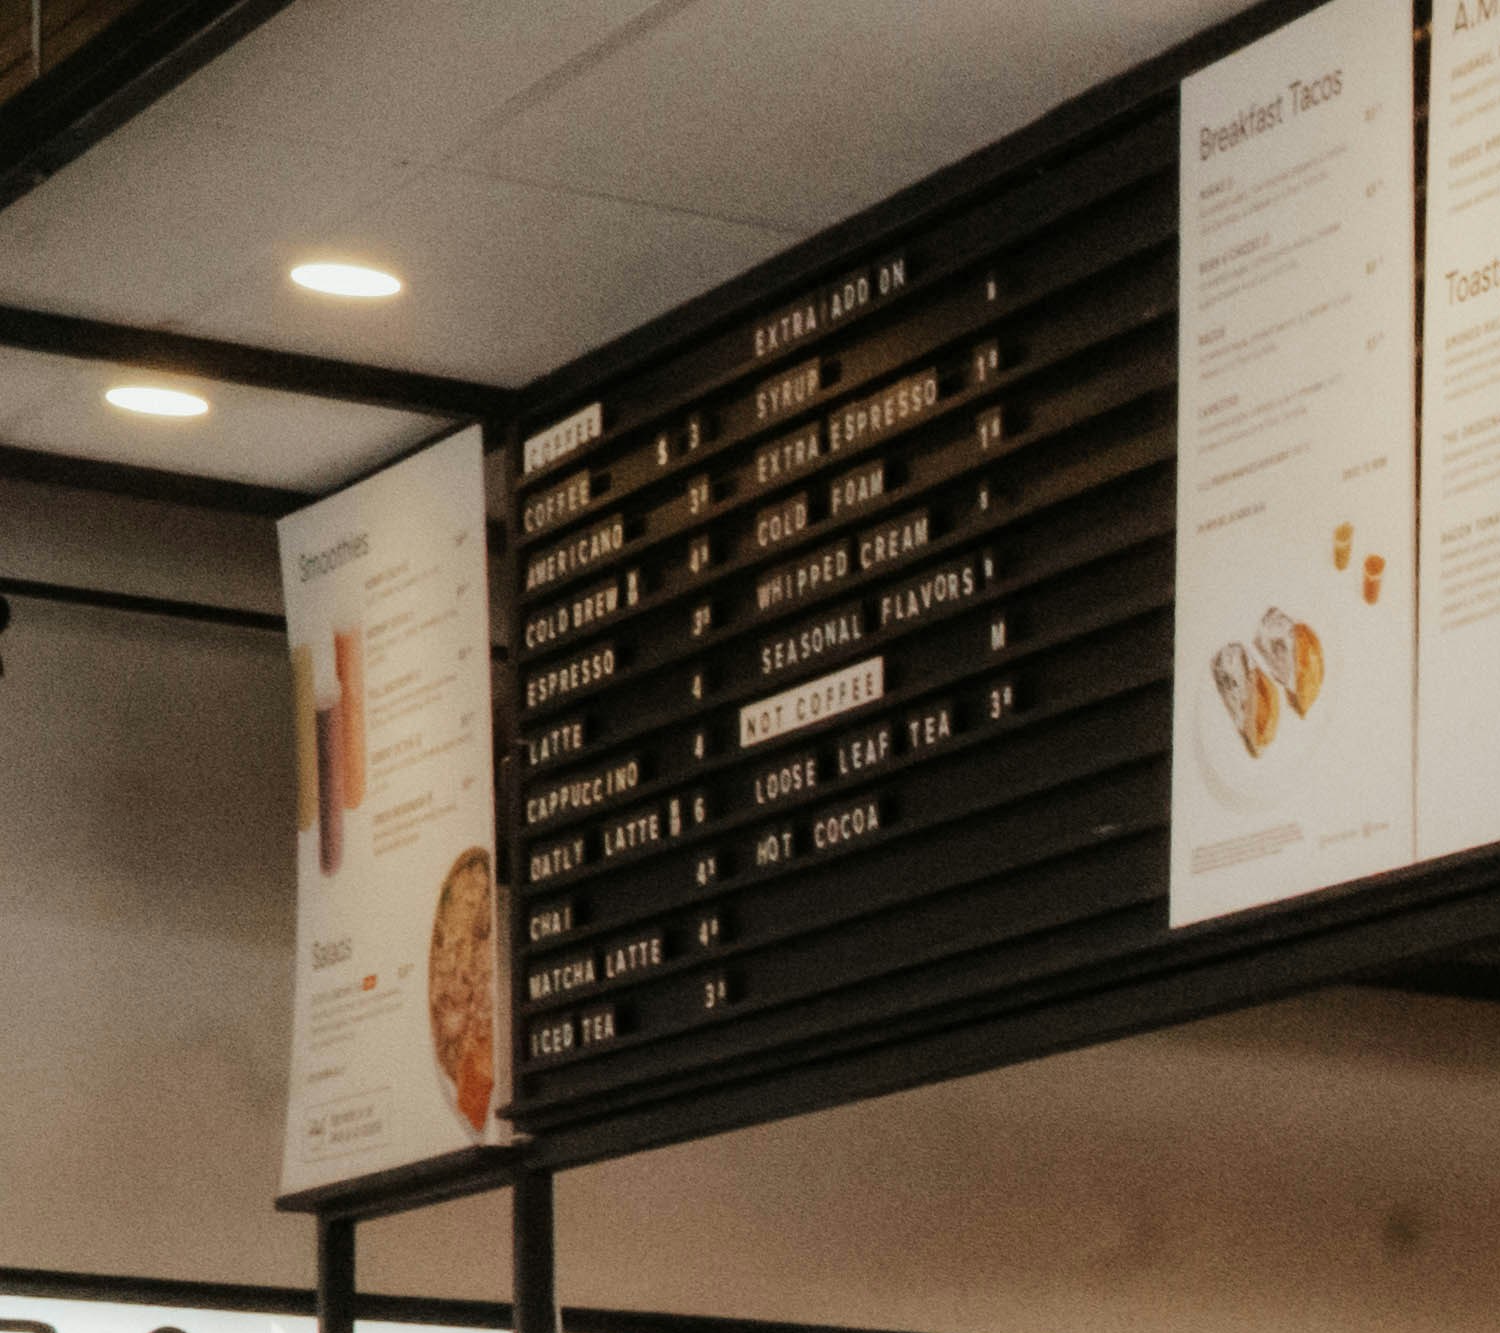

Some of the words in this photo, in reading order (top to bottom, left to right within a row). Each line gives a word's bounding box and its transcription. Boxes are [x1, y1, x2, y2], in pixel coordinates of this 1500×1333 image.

[1201, 97, 1283, 160] Breakfast
[1289, 69, 1342, 113] Tacos
[755, 306, 816, 356] EXTRA
[832, 278, 868, 320] ADD
[880, 259, 904, 294] ON
[757, 369, 818, 419] SYRUP
[758, 434, 819, 483] EXTRA
[830, 379, 936, 450] ESPRESSO
[525, 480, 589, 532] COFFEE
[758, 503, 806, 546] COLD
[832, 468, 883, 514] FOAM
[300, 533, 369, 583] Smoothies
[527, 524, 623, 590] AMERICANO
[757, 551, 847, 609] WHIPPED
[861, 518, 928, 569] CREAM
[526, 608, 568, 648] COLD
[573, 587, 618, 628] BREW
[762, 616, 861, 674] SEASONAL
[882, 568, 974, 625] FLAVORS
[527, 650, 614, 707] ESPRESSO
[748, 706, 782, 737] NOT
[797, 672, 873, 721] COFFEE
[530, 724, 582, 765] LATTE
[756, 760, 815, 803] LOOSE
[839, 732, 888, 774] LEAF
[910, 711, 949, 747] TEA
[527, 762, 638, 824] CAPPUCCINO
[530, 839, 583, 882] OATLY
[605, 815, 658, 855] LATTE
[757, 833, 791, 866] HOT
[814, 804, 879, 848] COCOA
[530, 906, 571, 941] CHAI
[529, 960, 595, 1000] MATCHA
[606, 938, 661, 978] LATTE
[532, 1022, 573, 1056] ICED
[582, 1013, 614, 1044] TEA
